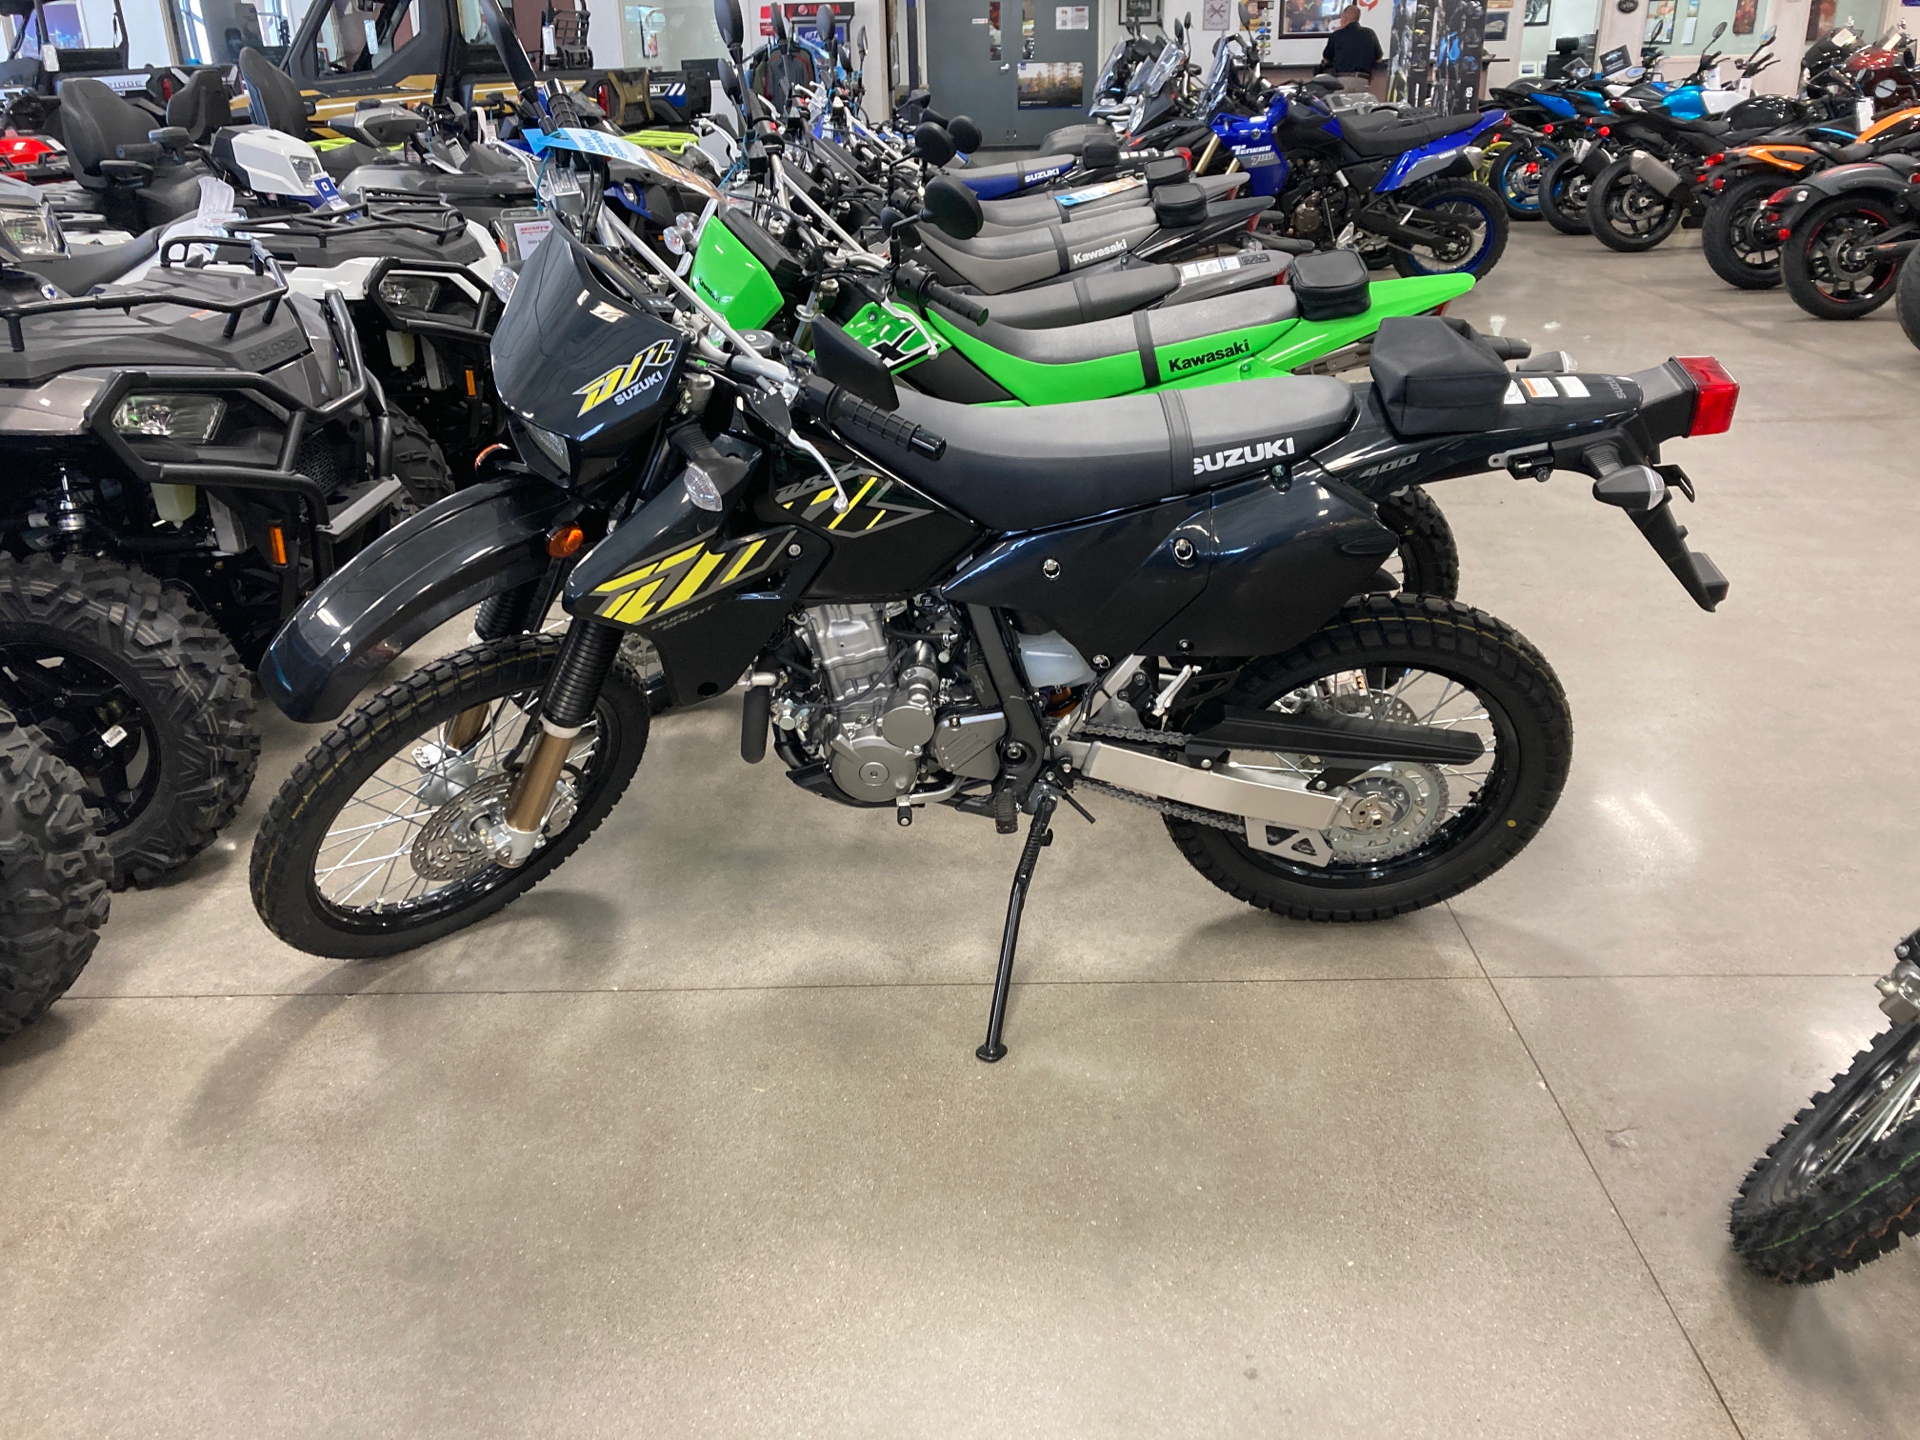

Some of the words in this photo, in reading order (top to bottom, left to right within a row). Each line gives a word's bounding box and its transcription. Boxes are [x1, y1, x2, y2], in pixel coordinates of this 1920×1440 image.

[1024, 168, 1060, 182] SUZUKI
[1072, 238, 1128, 264] Kawasaki
[246, 335, 299, 366] POLARIS
[1168, 339, 1251, 372] Kawasaki
[613, 370, 664, 406] SUZUKI
[1193, 437, 1296, 476] SUZUKI
[1359, 453, 1420, 479] 400
[662, 603, 717, 631] SPORT
